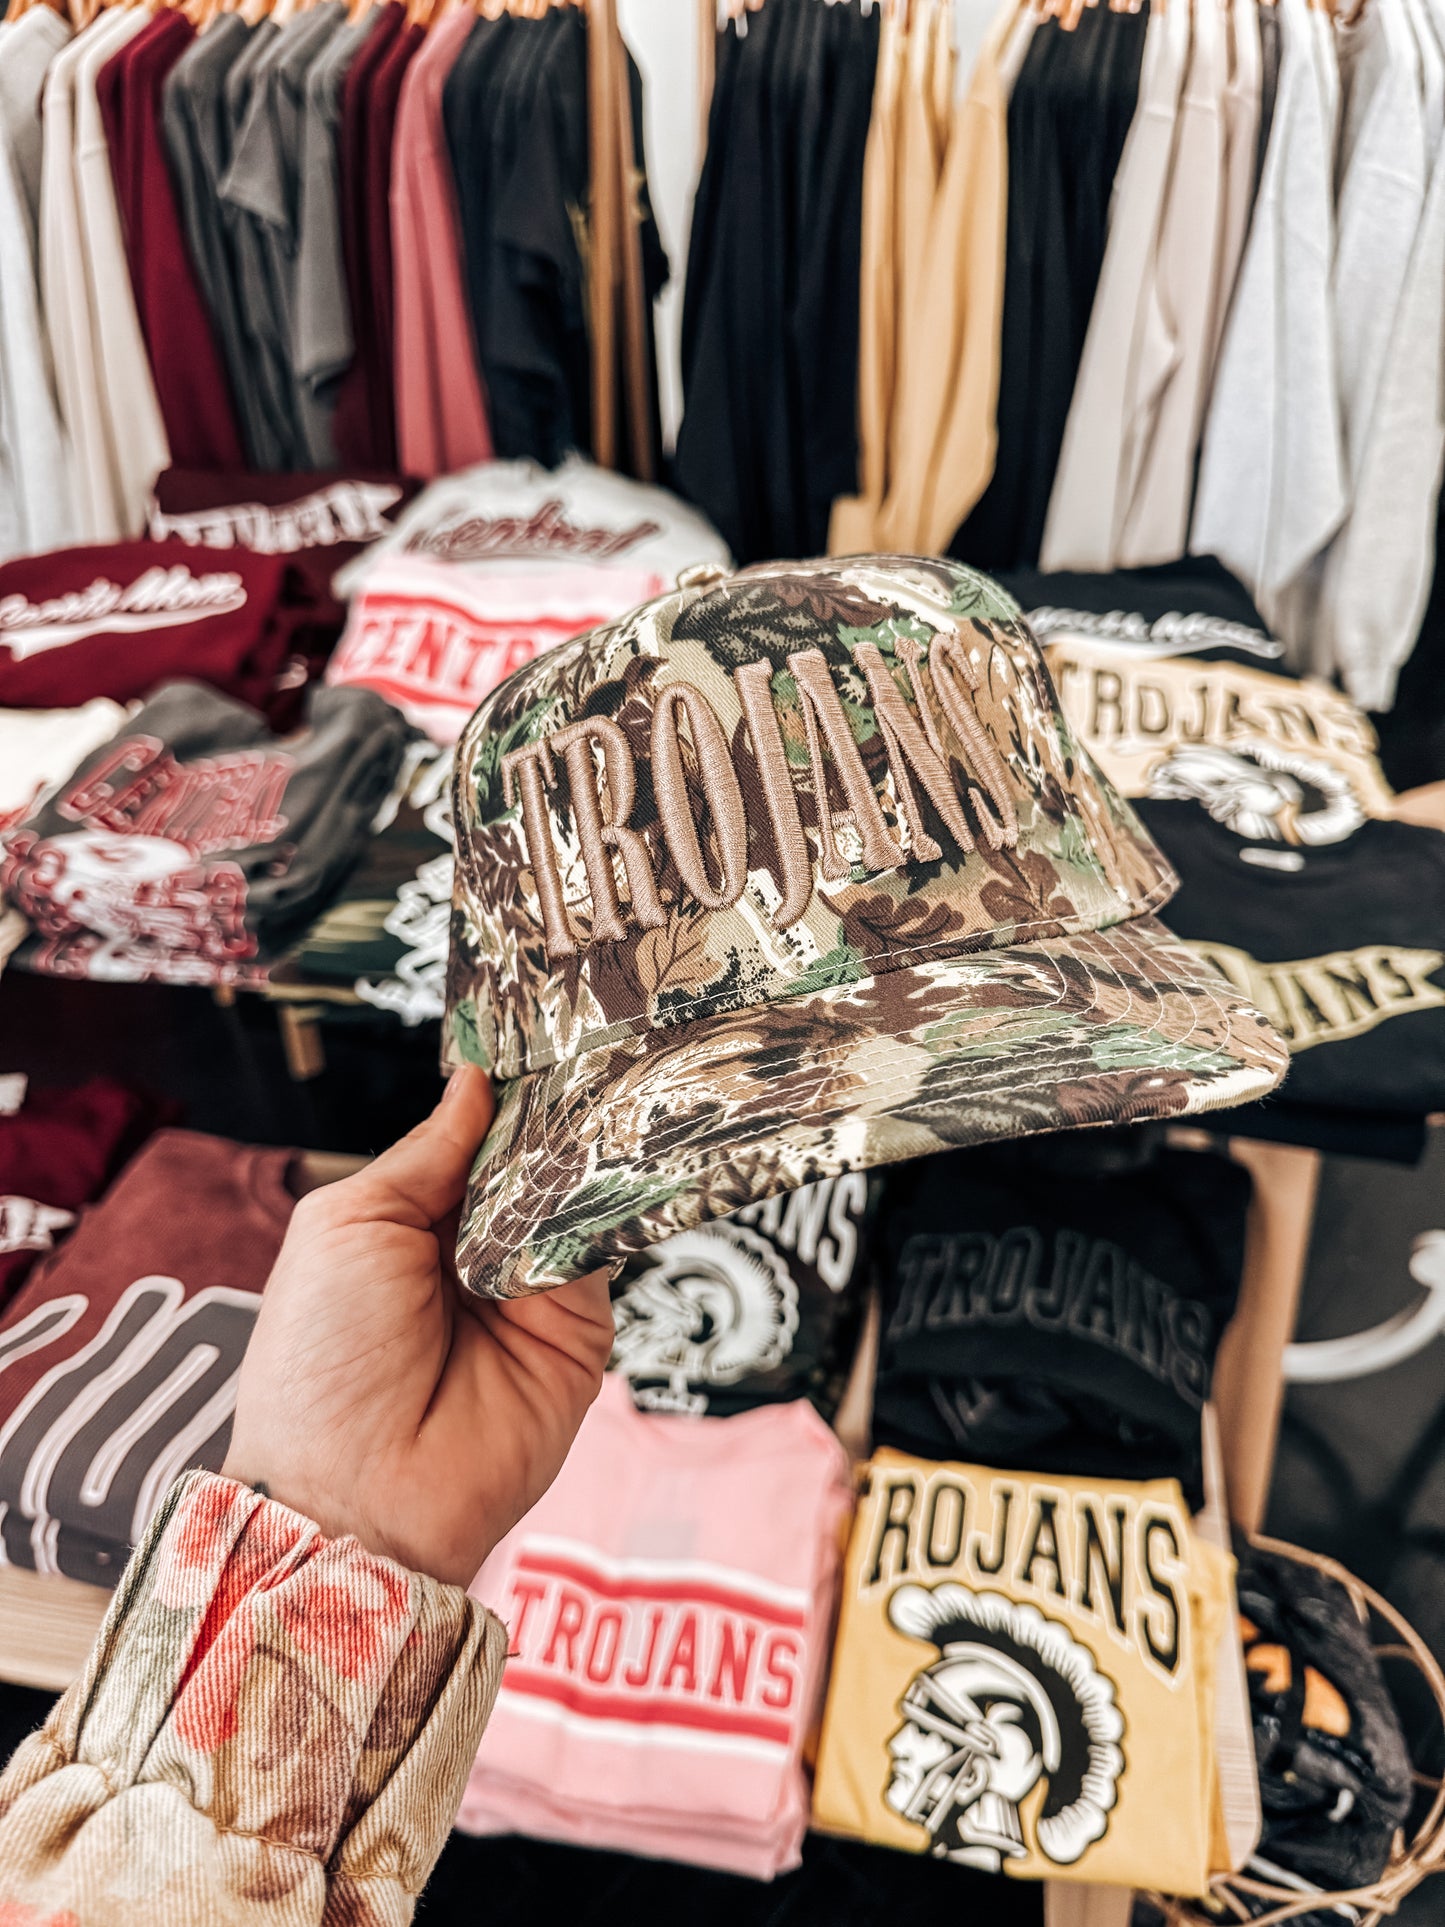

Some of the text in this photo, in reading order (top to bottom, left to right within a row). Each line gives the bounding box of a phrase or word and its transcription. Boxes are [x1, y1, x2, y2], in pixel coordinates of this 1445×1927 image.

[500, 632, 1019, 961] TROJANS
[885, 1225, 1214, 1410] TROJANS
[508, 1580, 798, 1709] TROJANS
[860, 1472, 1190, 1688] ROJANS
